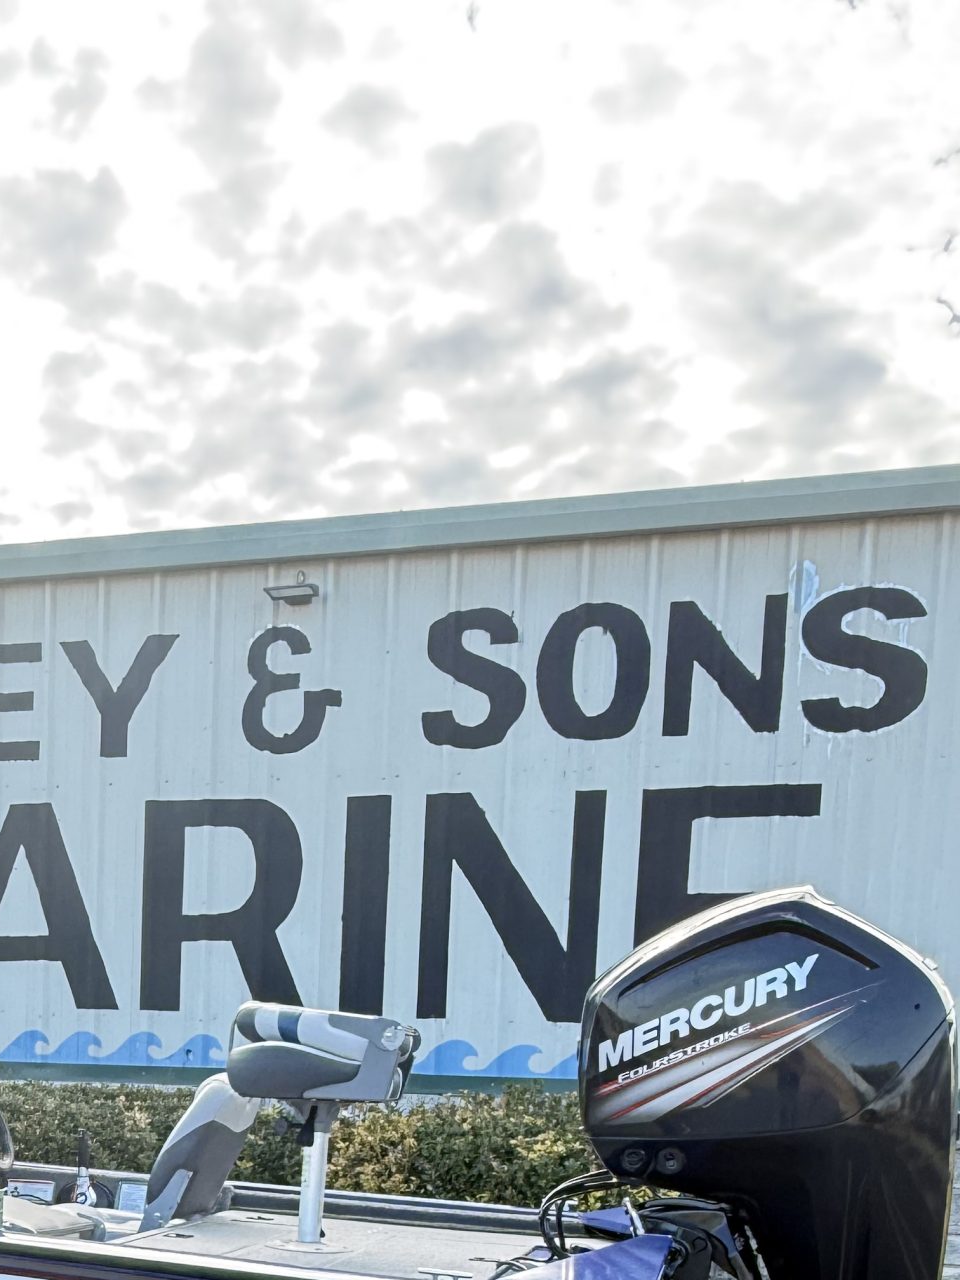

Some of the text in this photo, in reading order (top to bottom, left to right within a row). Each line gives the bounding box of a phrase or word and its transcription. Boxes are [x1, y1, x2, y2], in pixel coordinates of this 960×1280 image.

[241, 625, 343, 754] &
[421, 586, 928, 749] SONS
[598, 954, 819, 1073] MERCURY
[617, 1022, 751, 1084] FOURSTROKE
